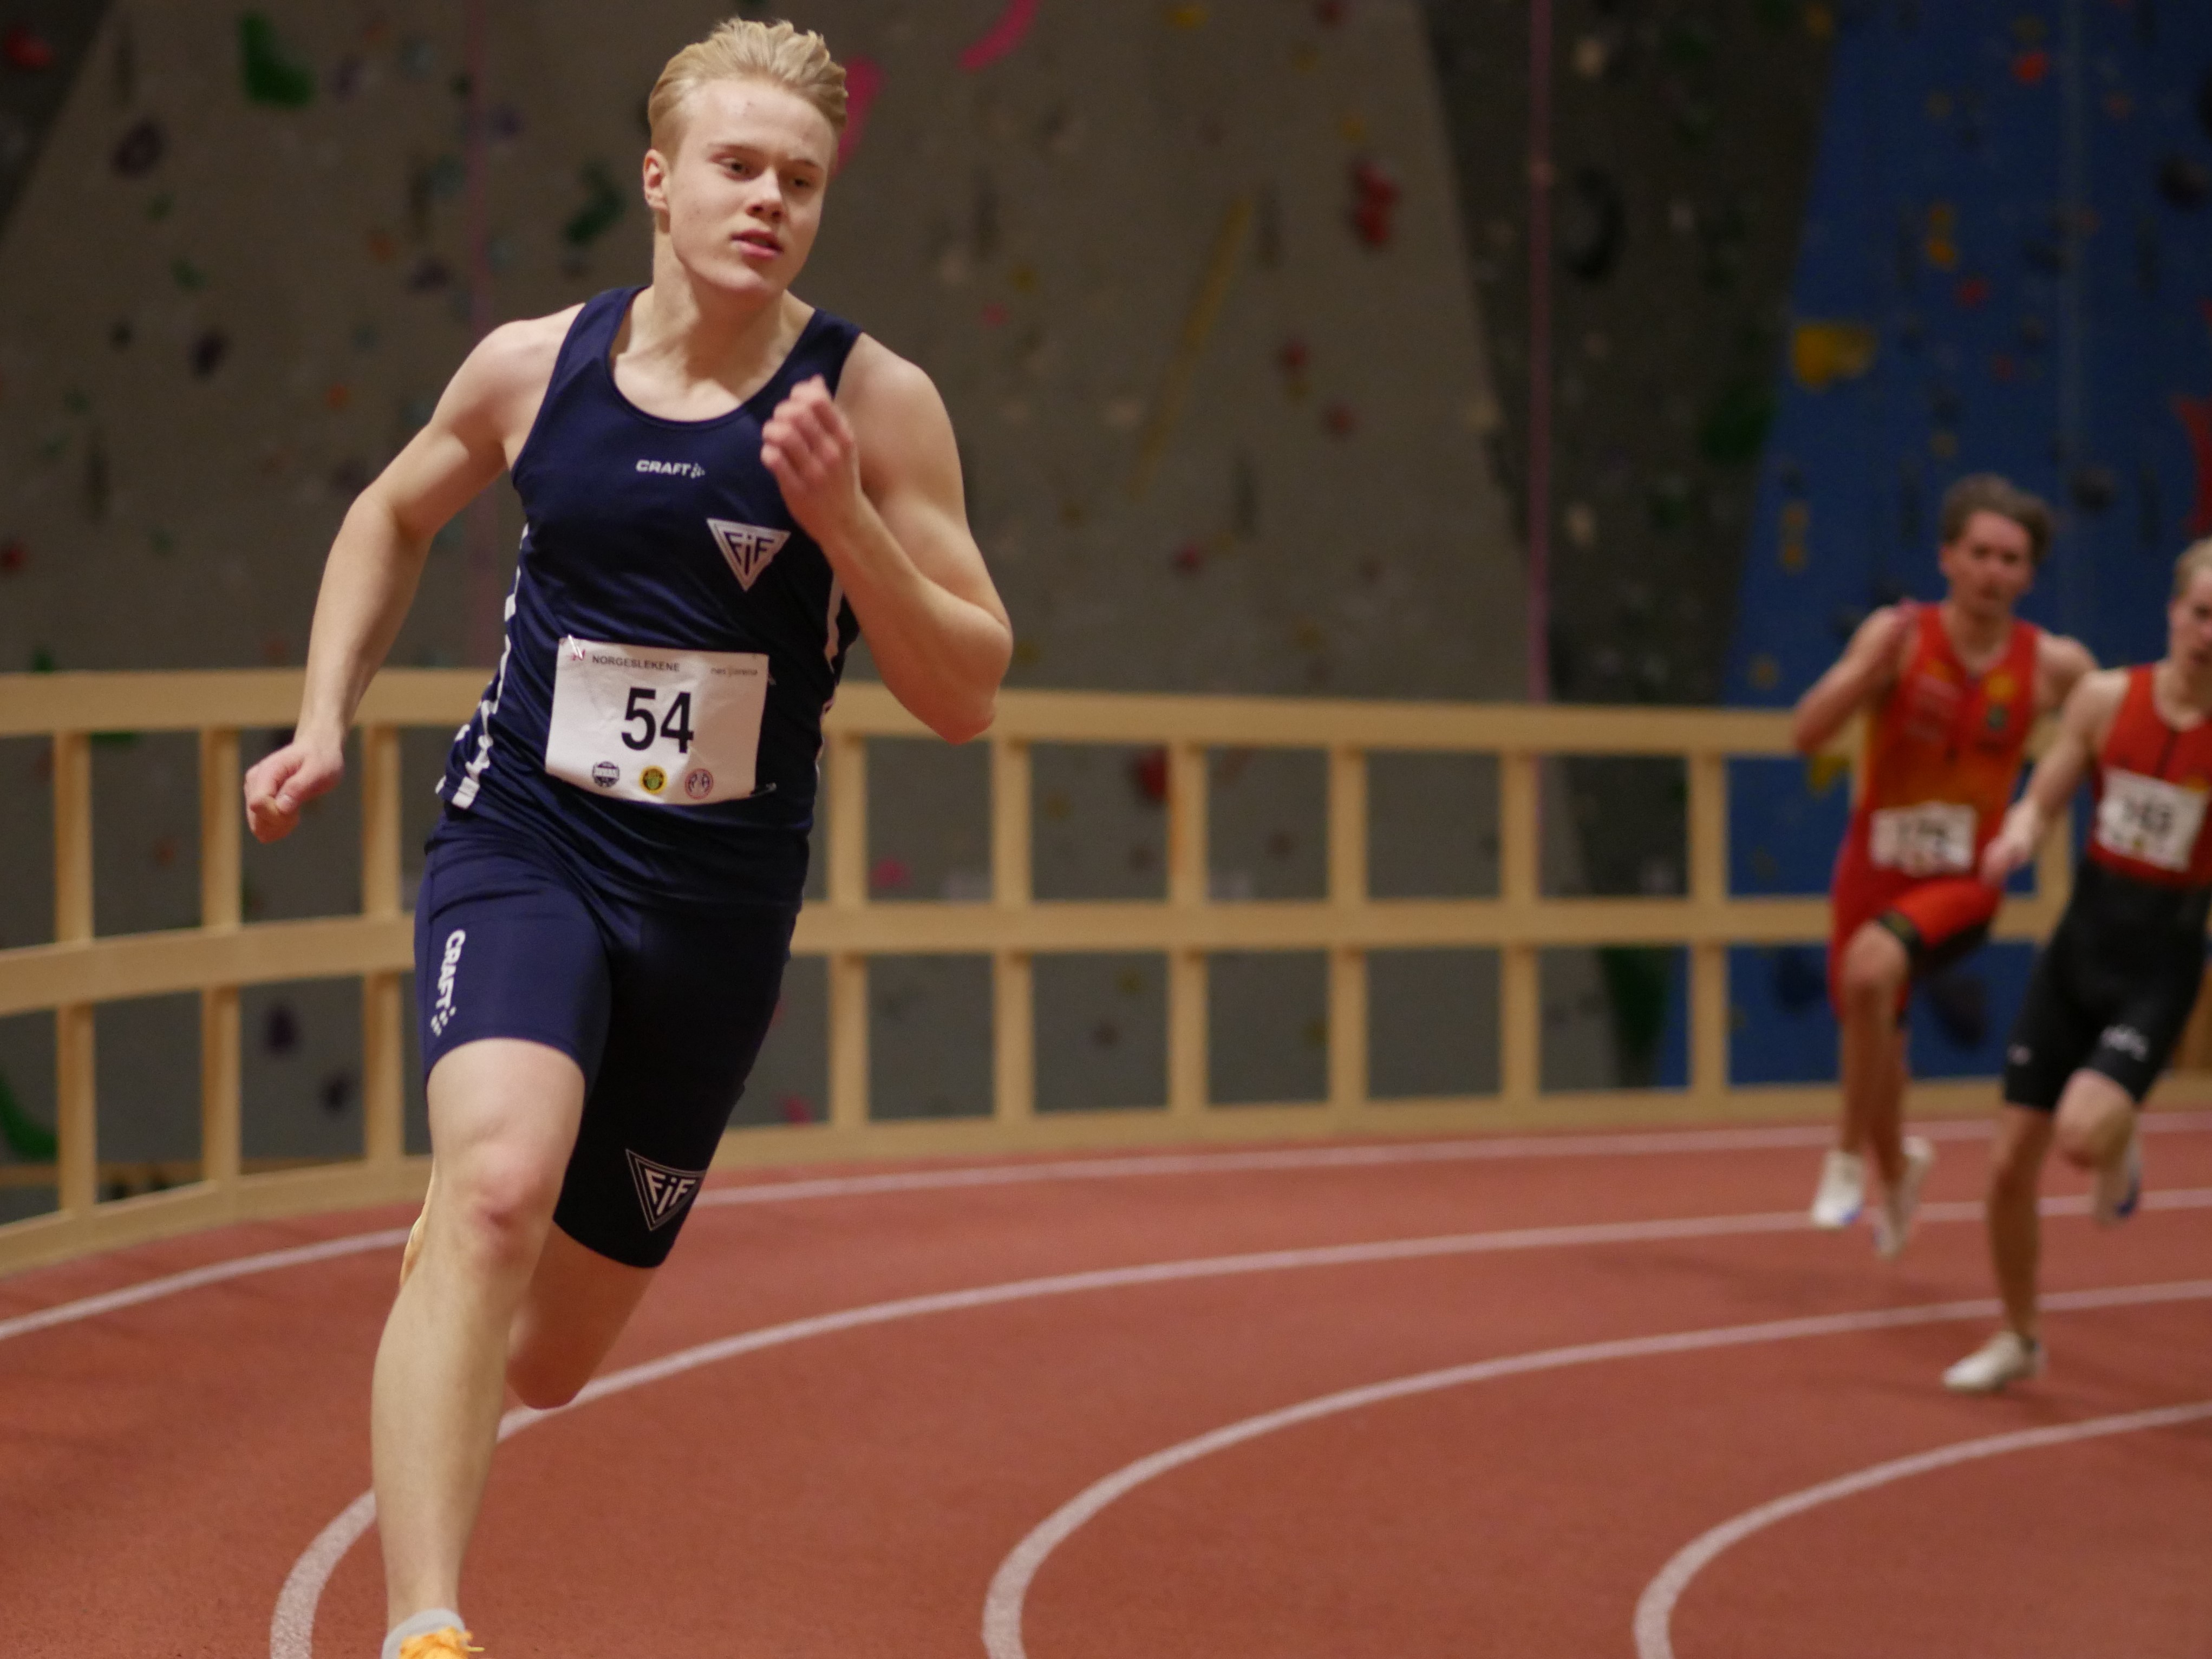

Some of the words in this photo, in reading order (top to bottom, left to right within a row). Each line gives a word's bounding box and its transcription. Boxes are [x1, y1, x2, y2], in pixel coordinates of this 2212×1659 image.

[635, 460, 692, 476] CRAFT
[592, 654, 680, 672] NORGESLEKENE
[621, 687, 694, 754] 54
[435, 929, 466, 1009] CRAFT
